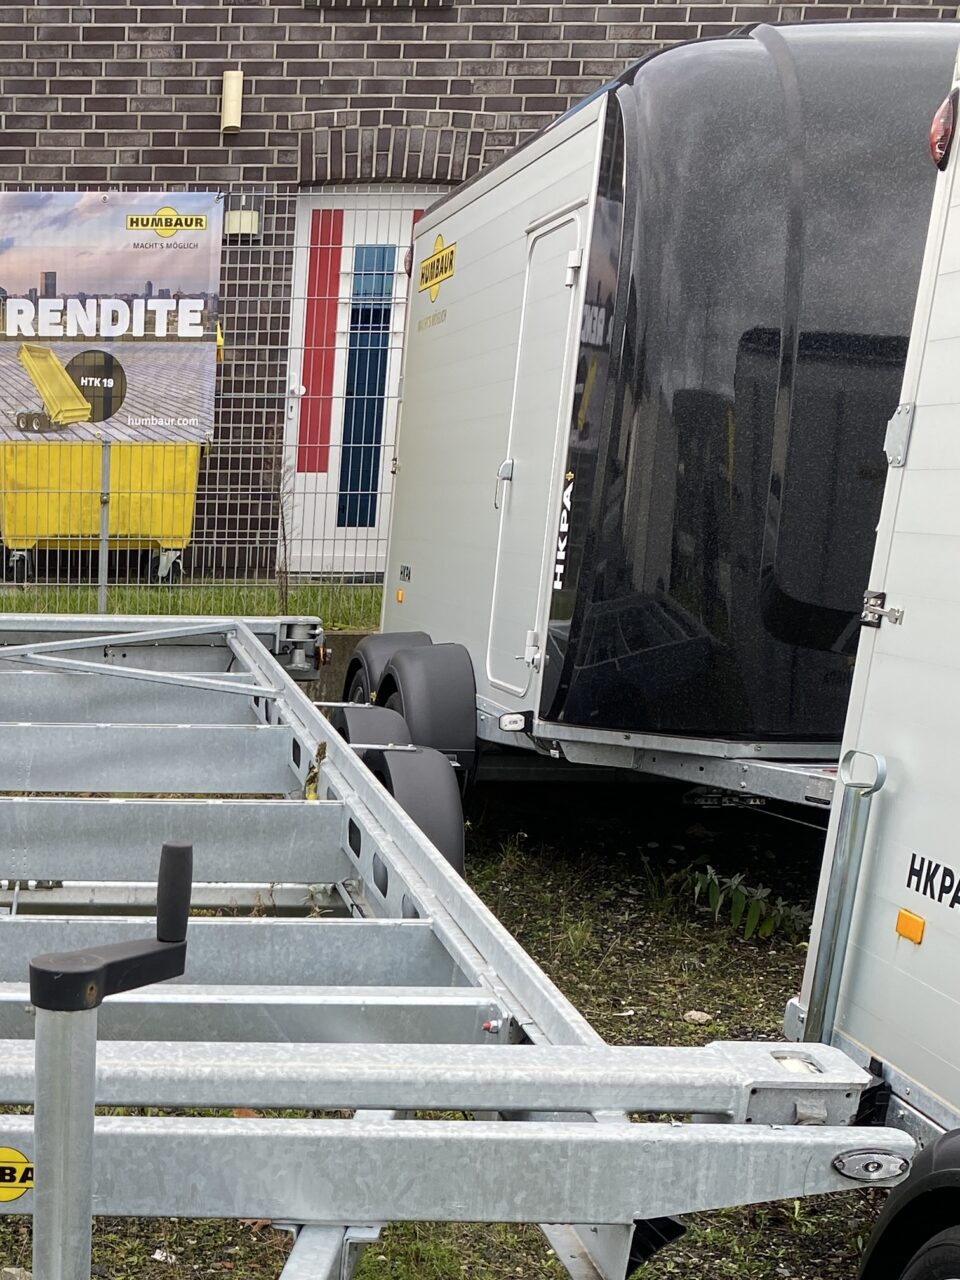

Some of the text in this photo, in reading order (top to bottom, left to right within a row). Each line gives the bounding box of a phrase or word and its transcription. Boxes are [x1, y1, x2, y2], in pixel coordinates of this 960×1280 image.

[129, 217, 204, 227] HUMBAUR
[166, 241, 199, 249] MÖGLICH
[420, 249, 455, 287] HUMBAUR
[5, 298, 204, 337] RENDITE
[80, 376, 114, 388] HTK 19
[127, 416, 199, 426] humbaur.com
